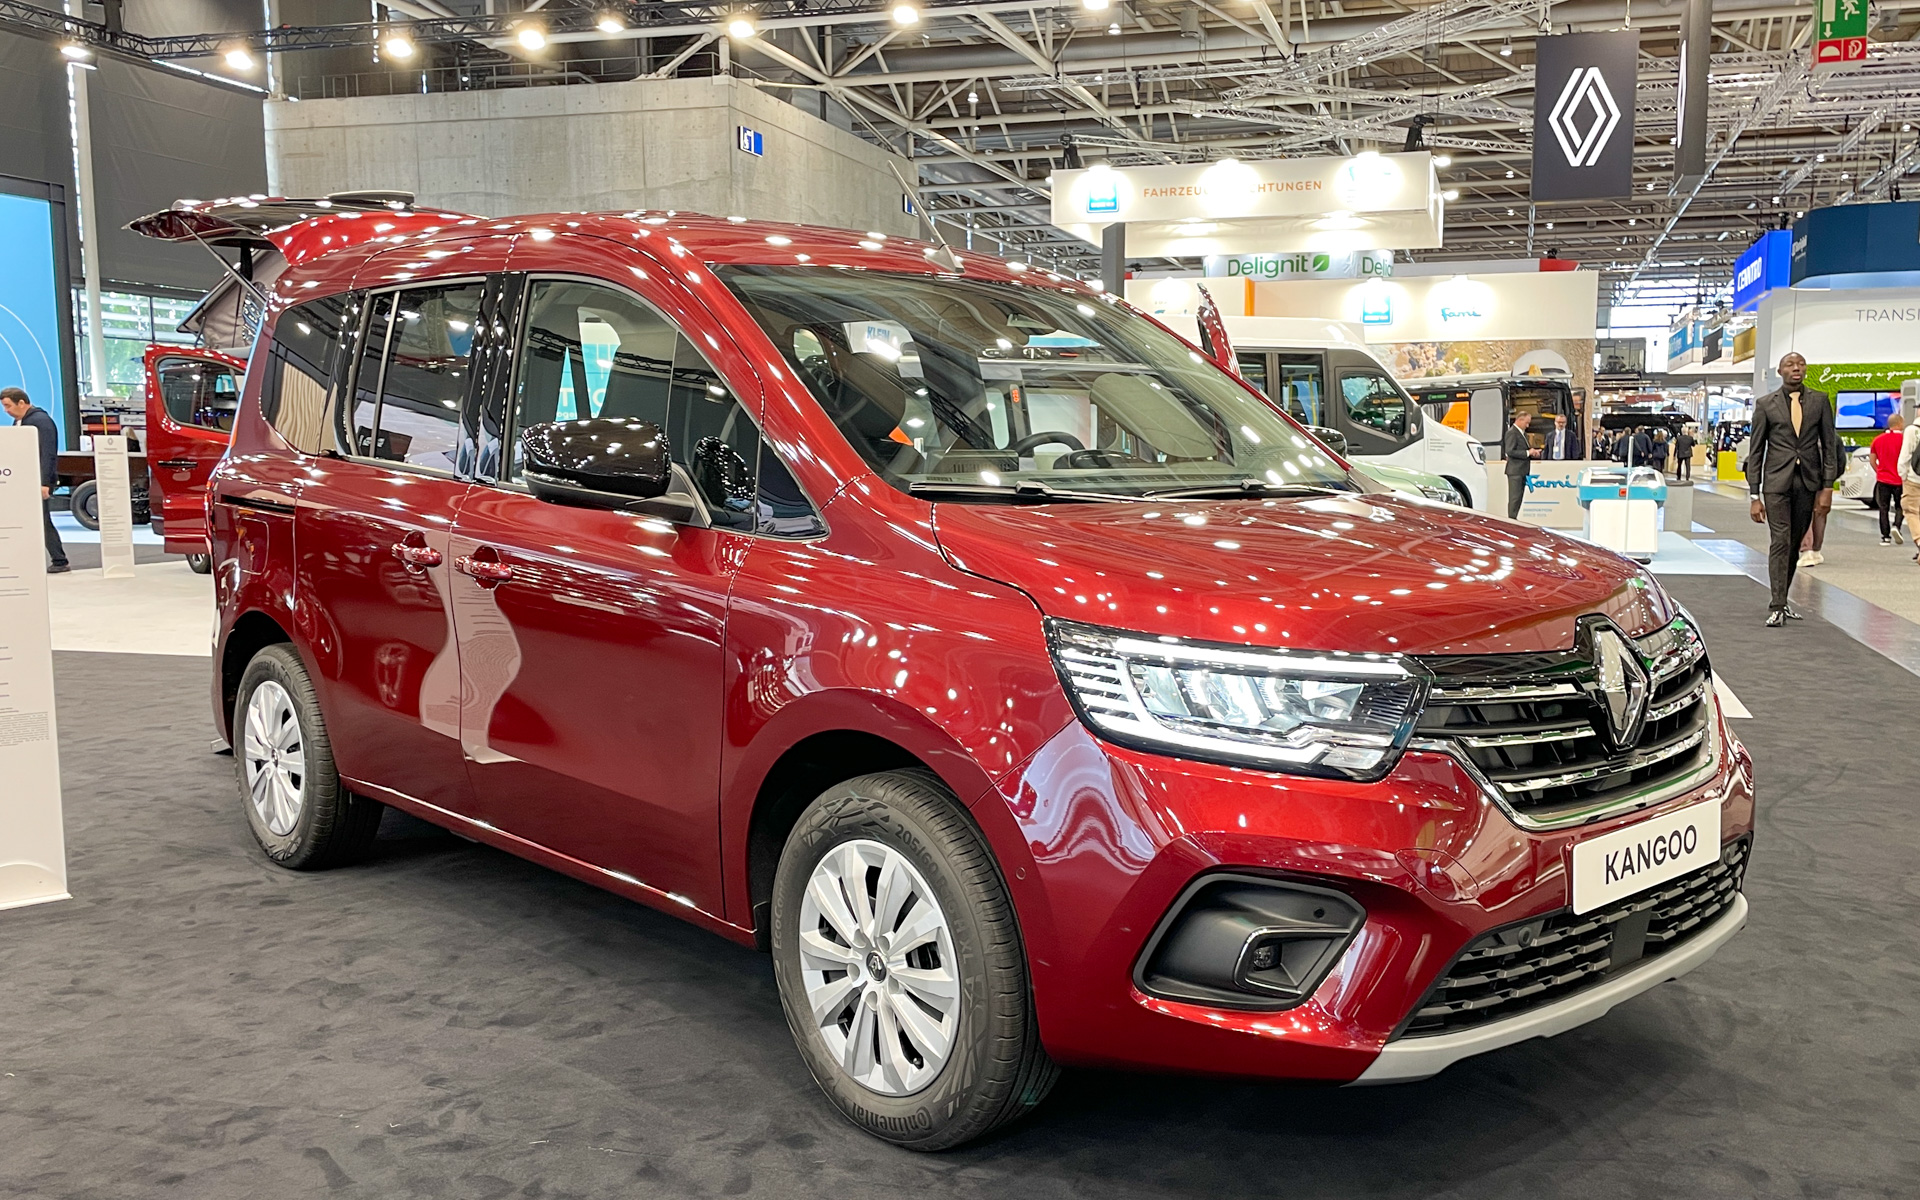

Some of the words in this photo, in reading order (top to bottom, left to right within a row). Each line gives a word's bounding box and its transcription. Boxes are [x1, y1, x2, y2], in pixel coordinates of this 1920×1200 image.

[1227, 254, 1309, 279] Delignit
[1855, 308, 1920, 322] TRANS
[1525, 474, 1578, 494] Fami
[895, 824, 939, 877] 205/60
[1605, 824, 1698, 885] KANGOO
[852, 1102, 933, 1137] Continental
